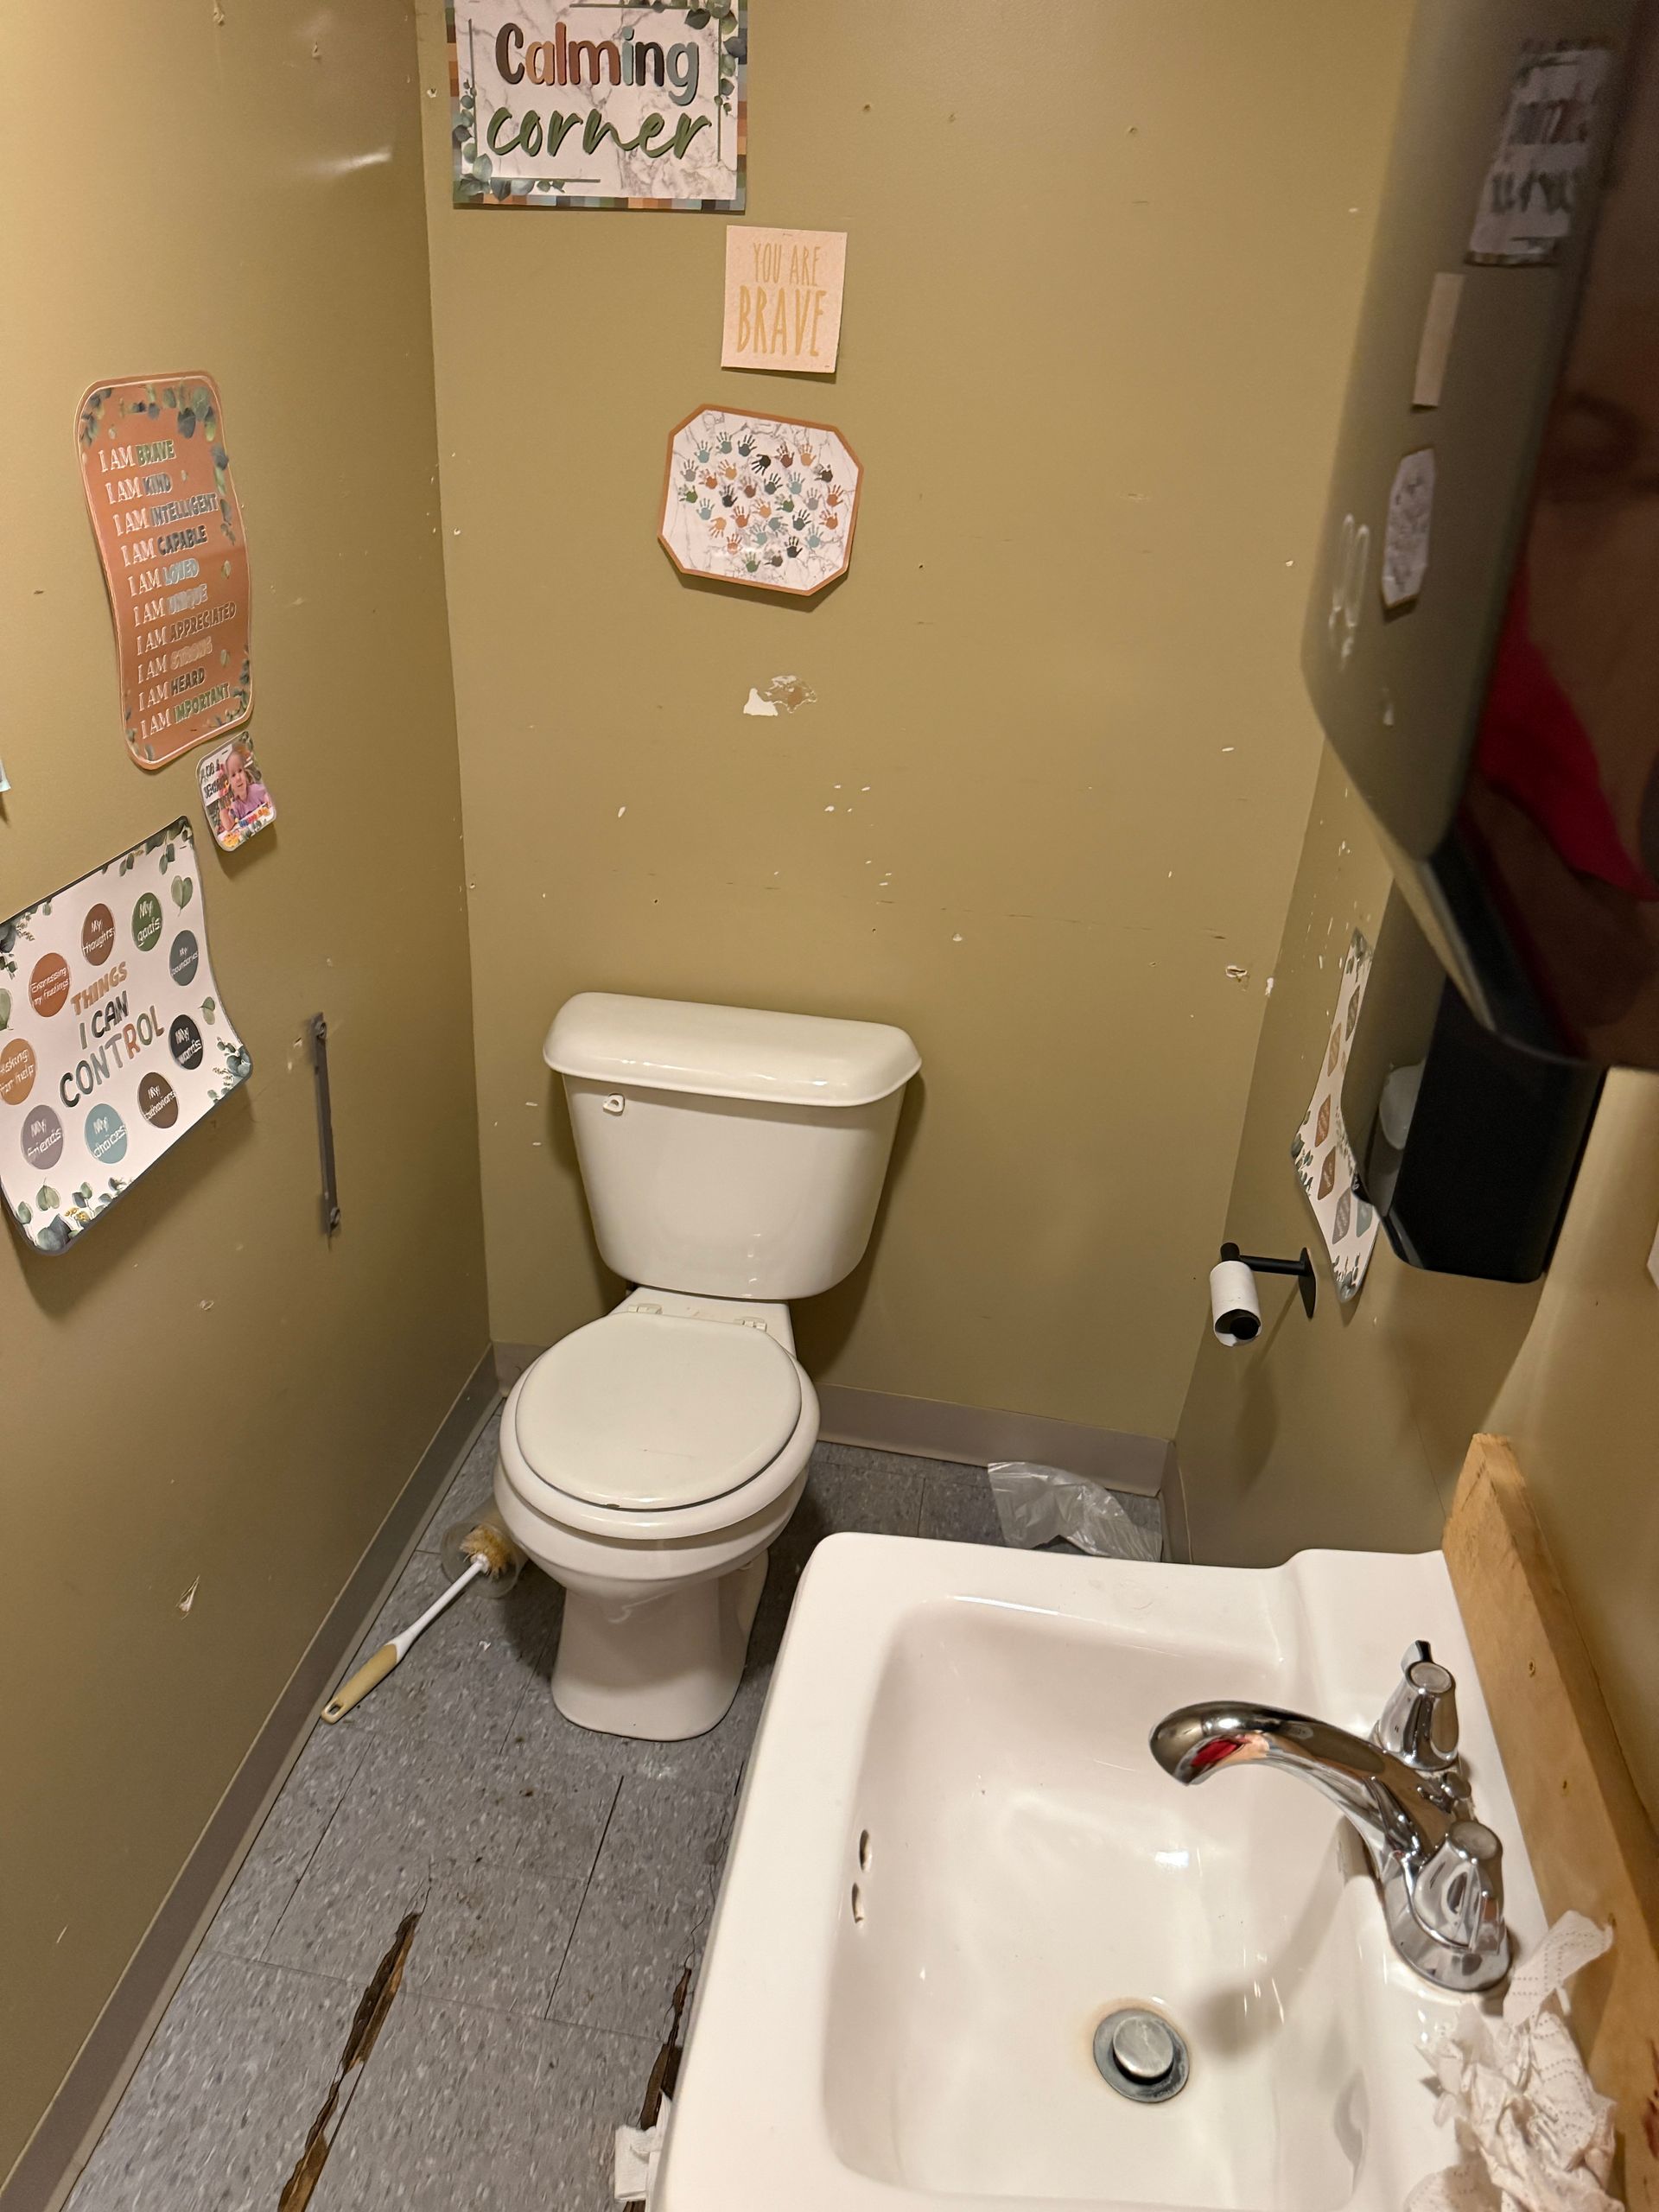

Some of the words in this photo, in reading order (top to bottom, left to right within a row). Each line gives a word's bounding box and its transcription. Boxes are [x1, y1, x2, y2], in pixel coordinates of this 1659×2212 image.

[495, 22, 699, 105] Calming
[486, 107, 712, 159] corner
[753, 243, 781, 283] YOU
[790, 245, 820, 286] ARE
[737, 285, 826, 357] BRAVE
[99, 449, 108, 473] I
[111, 445, 136, 471] AM
[136, 440, 176, 467] BRAVE
[105, 482, 115, 505] I
[118, 477, 143, 502] AM
[143, 473, 172, 496] KIND
[113, 514, 124, 536] I
[126, 508, 149, 534] AM
[150, 493, 219, 527] INTELLIGENT
[121, 545, 131, 567] I
[133, 538, 156, 564] AM
[157, 525, 208, 556] CAPABLE
[128, 575, 137, 597] I
[139, 569, 162, 594] AM
[163, 558, 200, 586] LOVED
[133, 606, 143, 626] I
[143, 598, 166, 624] AM
[137, 636, 143, 656] I
[145, 626, 167, 652] AM
[170, 601, 237, 642] APPRECIATED
[137, 664, 144, 684] I
[146, 655, 168, 680] AM
[139, 692, 145, 711] I
[147, 682, 168, 708] AM
[171, 667, 206, 696] HEARD
[140, 720, 147, 740] I
[150, 709, 172, 734] AM
[173, 683, 231, 723] IMPORTANT
[91, 918, 103, 933] My
[139, 900, 153, 918] My
[82, 926, 115, 956] thoughts
[137, 918, 162, 947] goals
[30, 967, 67, 993] Expressing
[44, 978, 69, 998] feelings
[70, 961, 128, 1016] THINGS
[79, 1022, 88, 1050] I
[91, 990, 129, 1038] CAN
[60, 1005, 164, 1108] CONTROL
[27, 1128, 62, 1156] friends
[93, 1125, 127, 1158] choices
